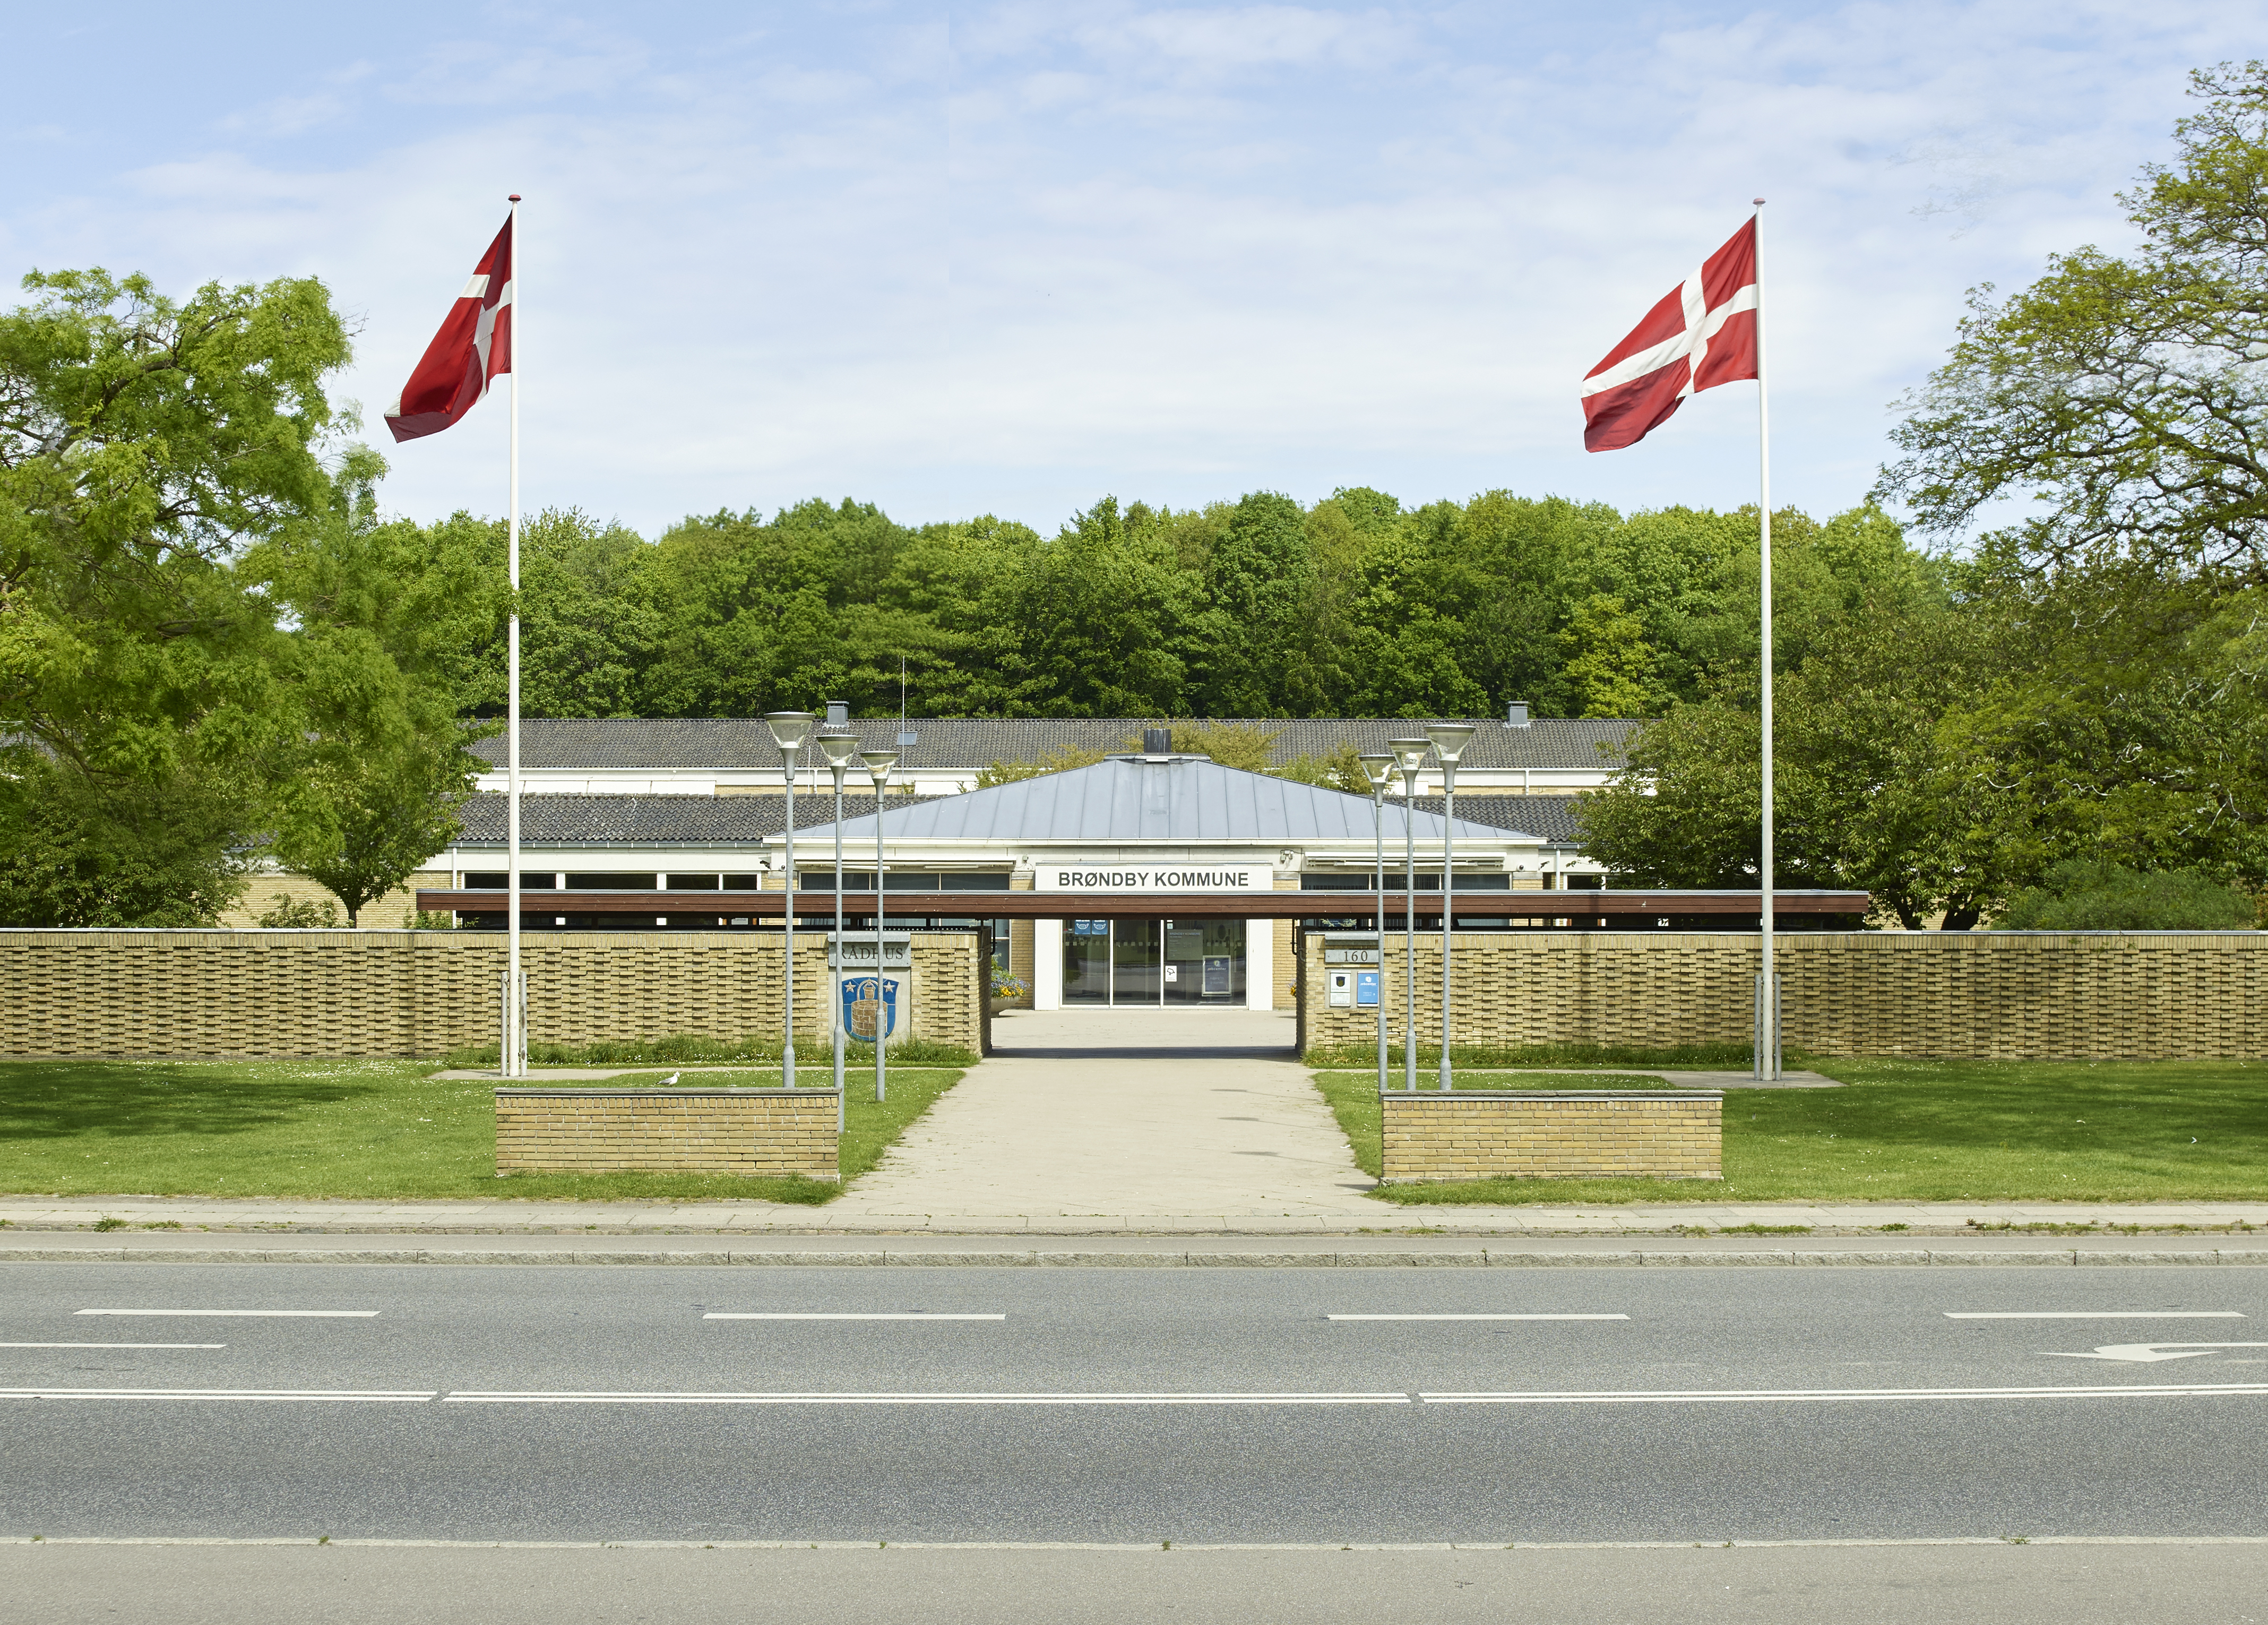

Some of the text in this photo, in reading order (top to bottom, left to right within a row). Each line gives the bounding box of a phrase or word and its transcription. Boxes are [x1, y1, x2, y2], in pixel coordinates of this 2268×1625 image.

[1059, 872, 1248, 887] BRØNDBY KOMMUNE
[1344, 950, 1368, 962] 160
